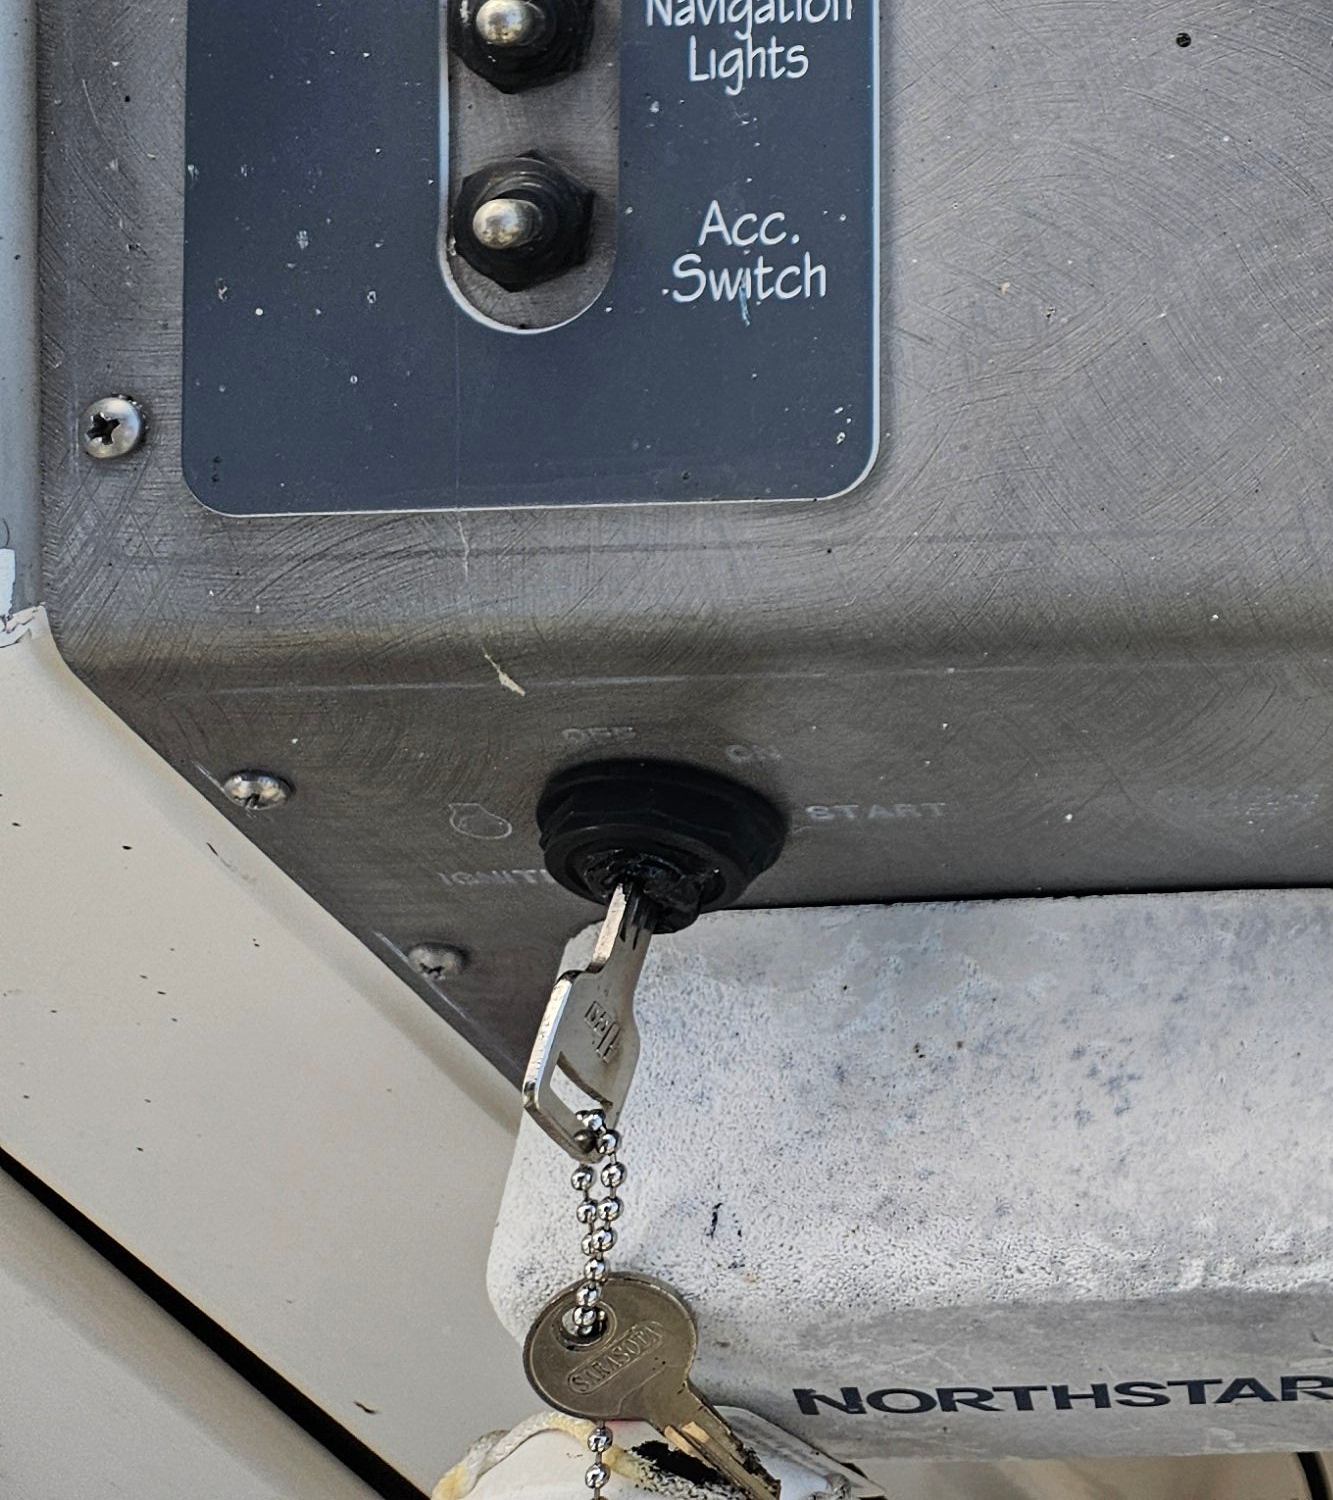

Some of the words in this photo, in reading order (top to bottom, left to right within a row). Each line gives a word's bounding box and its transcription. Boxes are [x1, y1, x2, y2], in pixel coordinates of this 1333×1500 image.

[689, 36, 809, 96] Lights
[698, 200, 800, 246] Acc.
[671, 251, 827, 303] Switch
[562, 726, 637, 744] OFF
[805, 802, 947, 821] START
[437, 868, 557, 886] IGNITI
